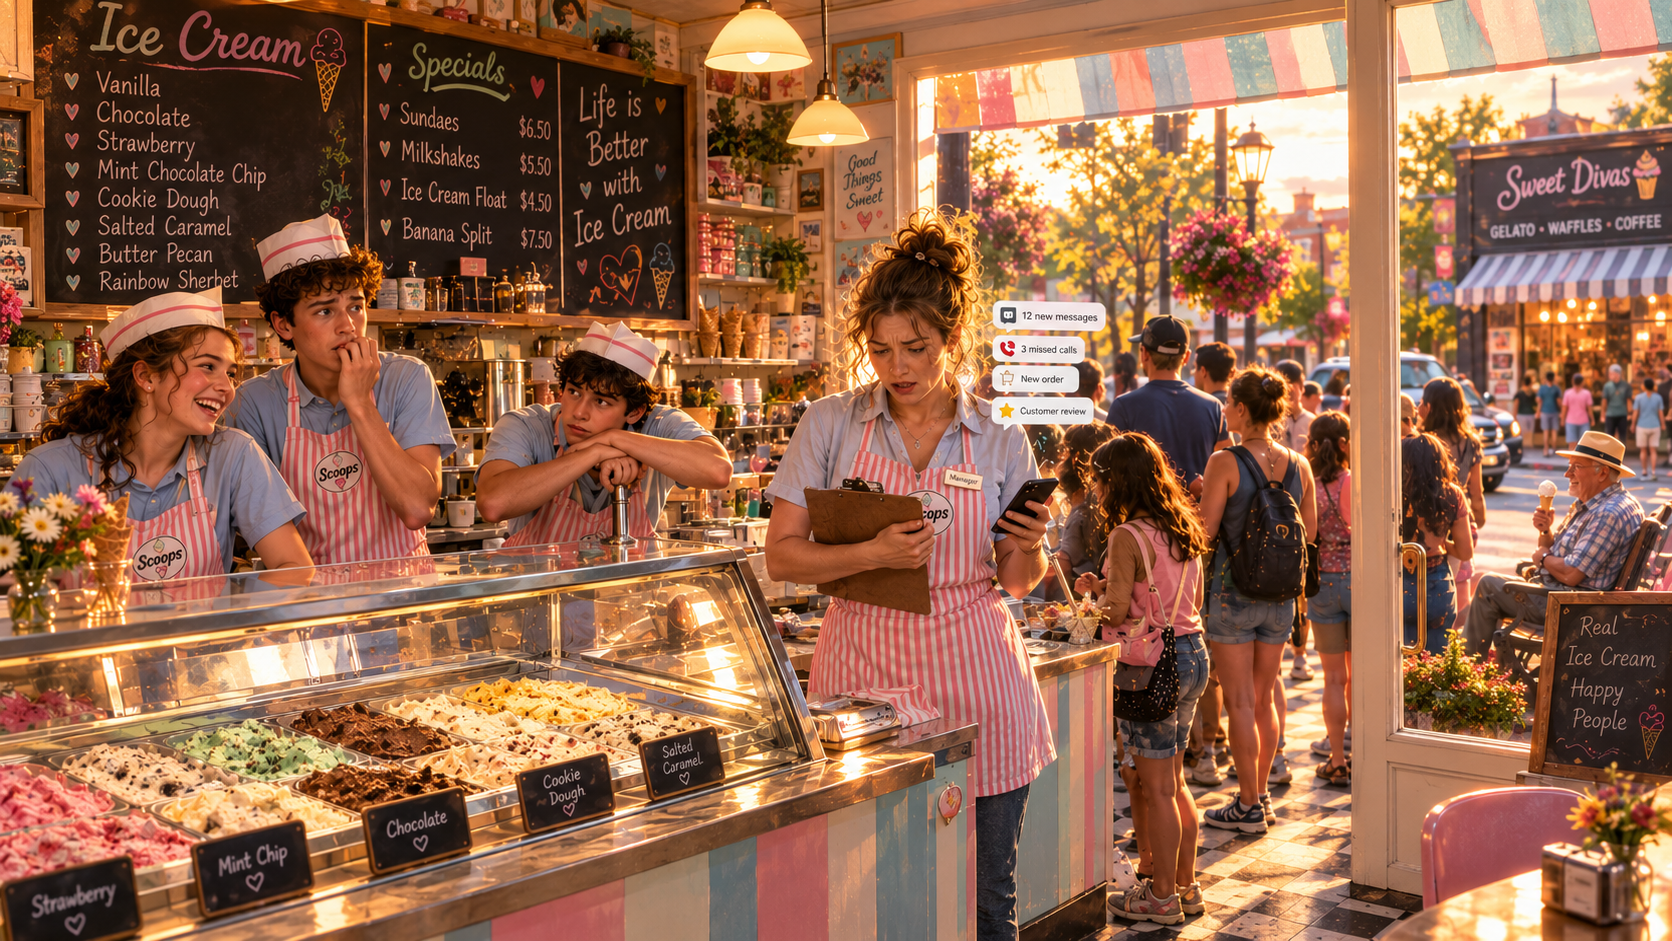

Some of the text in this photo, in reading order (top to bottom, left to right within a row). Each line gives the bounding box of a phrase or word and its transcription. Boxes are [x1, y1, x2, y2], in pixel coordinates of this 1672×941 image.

[90, 1, 306, 67] Ice Cream
[408, 42, 506, 93] Specials
[96, 70, 161, 98] Vanilla
[96, 101, 191, 128] Chocolate
[400, 102, 552, 140] Sundaes $6.50
[579, 83, 642, 129] Life is
[96, 129, 196, 162] Strawberry
[401, 140, 552, 177] Milkshakes $5.50
[586, 130, 649, 168] Better
[97, 158, 267, 191] Mint Chocolate Chip
[848, 150, 878, 173] Good
[401, 177, 552, 213] Ice Cream Float $4.50
[603, 166, 643, 198] with
[843, 170, 882, 192] Things
[1497, 158, 1631, 211] Sweet Divas
[97, 186, 219, 216] Cookie Dough
[97, 214, 232, 237] Salted Caramel
[402, 217, 553, 252] Banana Split $7.50
[573, 203, 672, 248] Ice Cream
[1490, 213, 1662, 240] GELATO WAFFLES COFFEE
[98, 242, 213, 264] Butter Pecan
[99, 269, 239, 292] Rainbow Sherbet
[319, 463, 359, 482] Scoops
[137, 549, 183, 571] Scoops
[1580, 615, 1618, 638] Real
[1566, 645, 1657, 668] Ice Cream
[1571, 677, 1624, 707] Happy
[1573, 707, 1627, 737] People
[662, 737, 693, 759] Salted
[662, 752, 704, 775] Caramel
[543, 768, 581, 790] Cookie
[549, 785, 586, 806] Dough
[386, 810, 448, 839] Chocolate
[218, 844, 289, 877] Mint Chip
[31, 883, 117, 919] Strawberry
